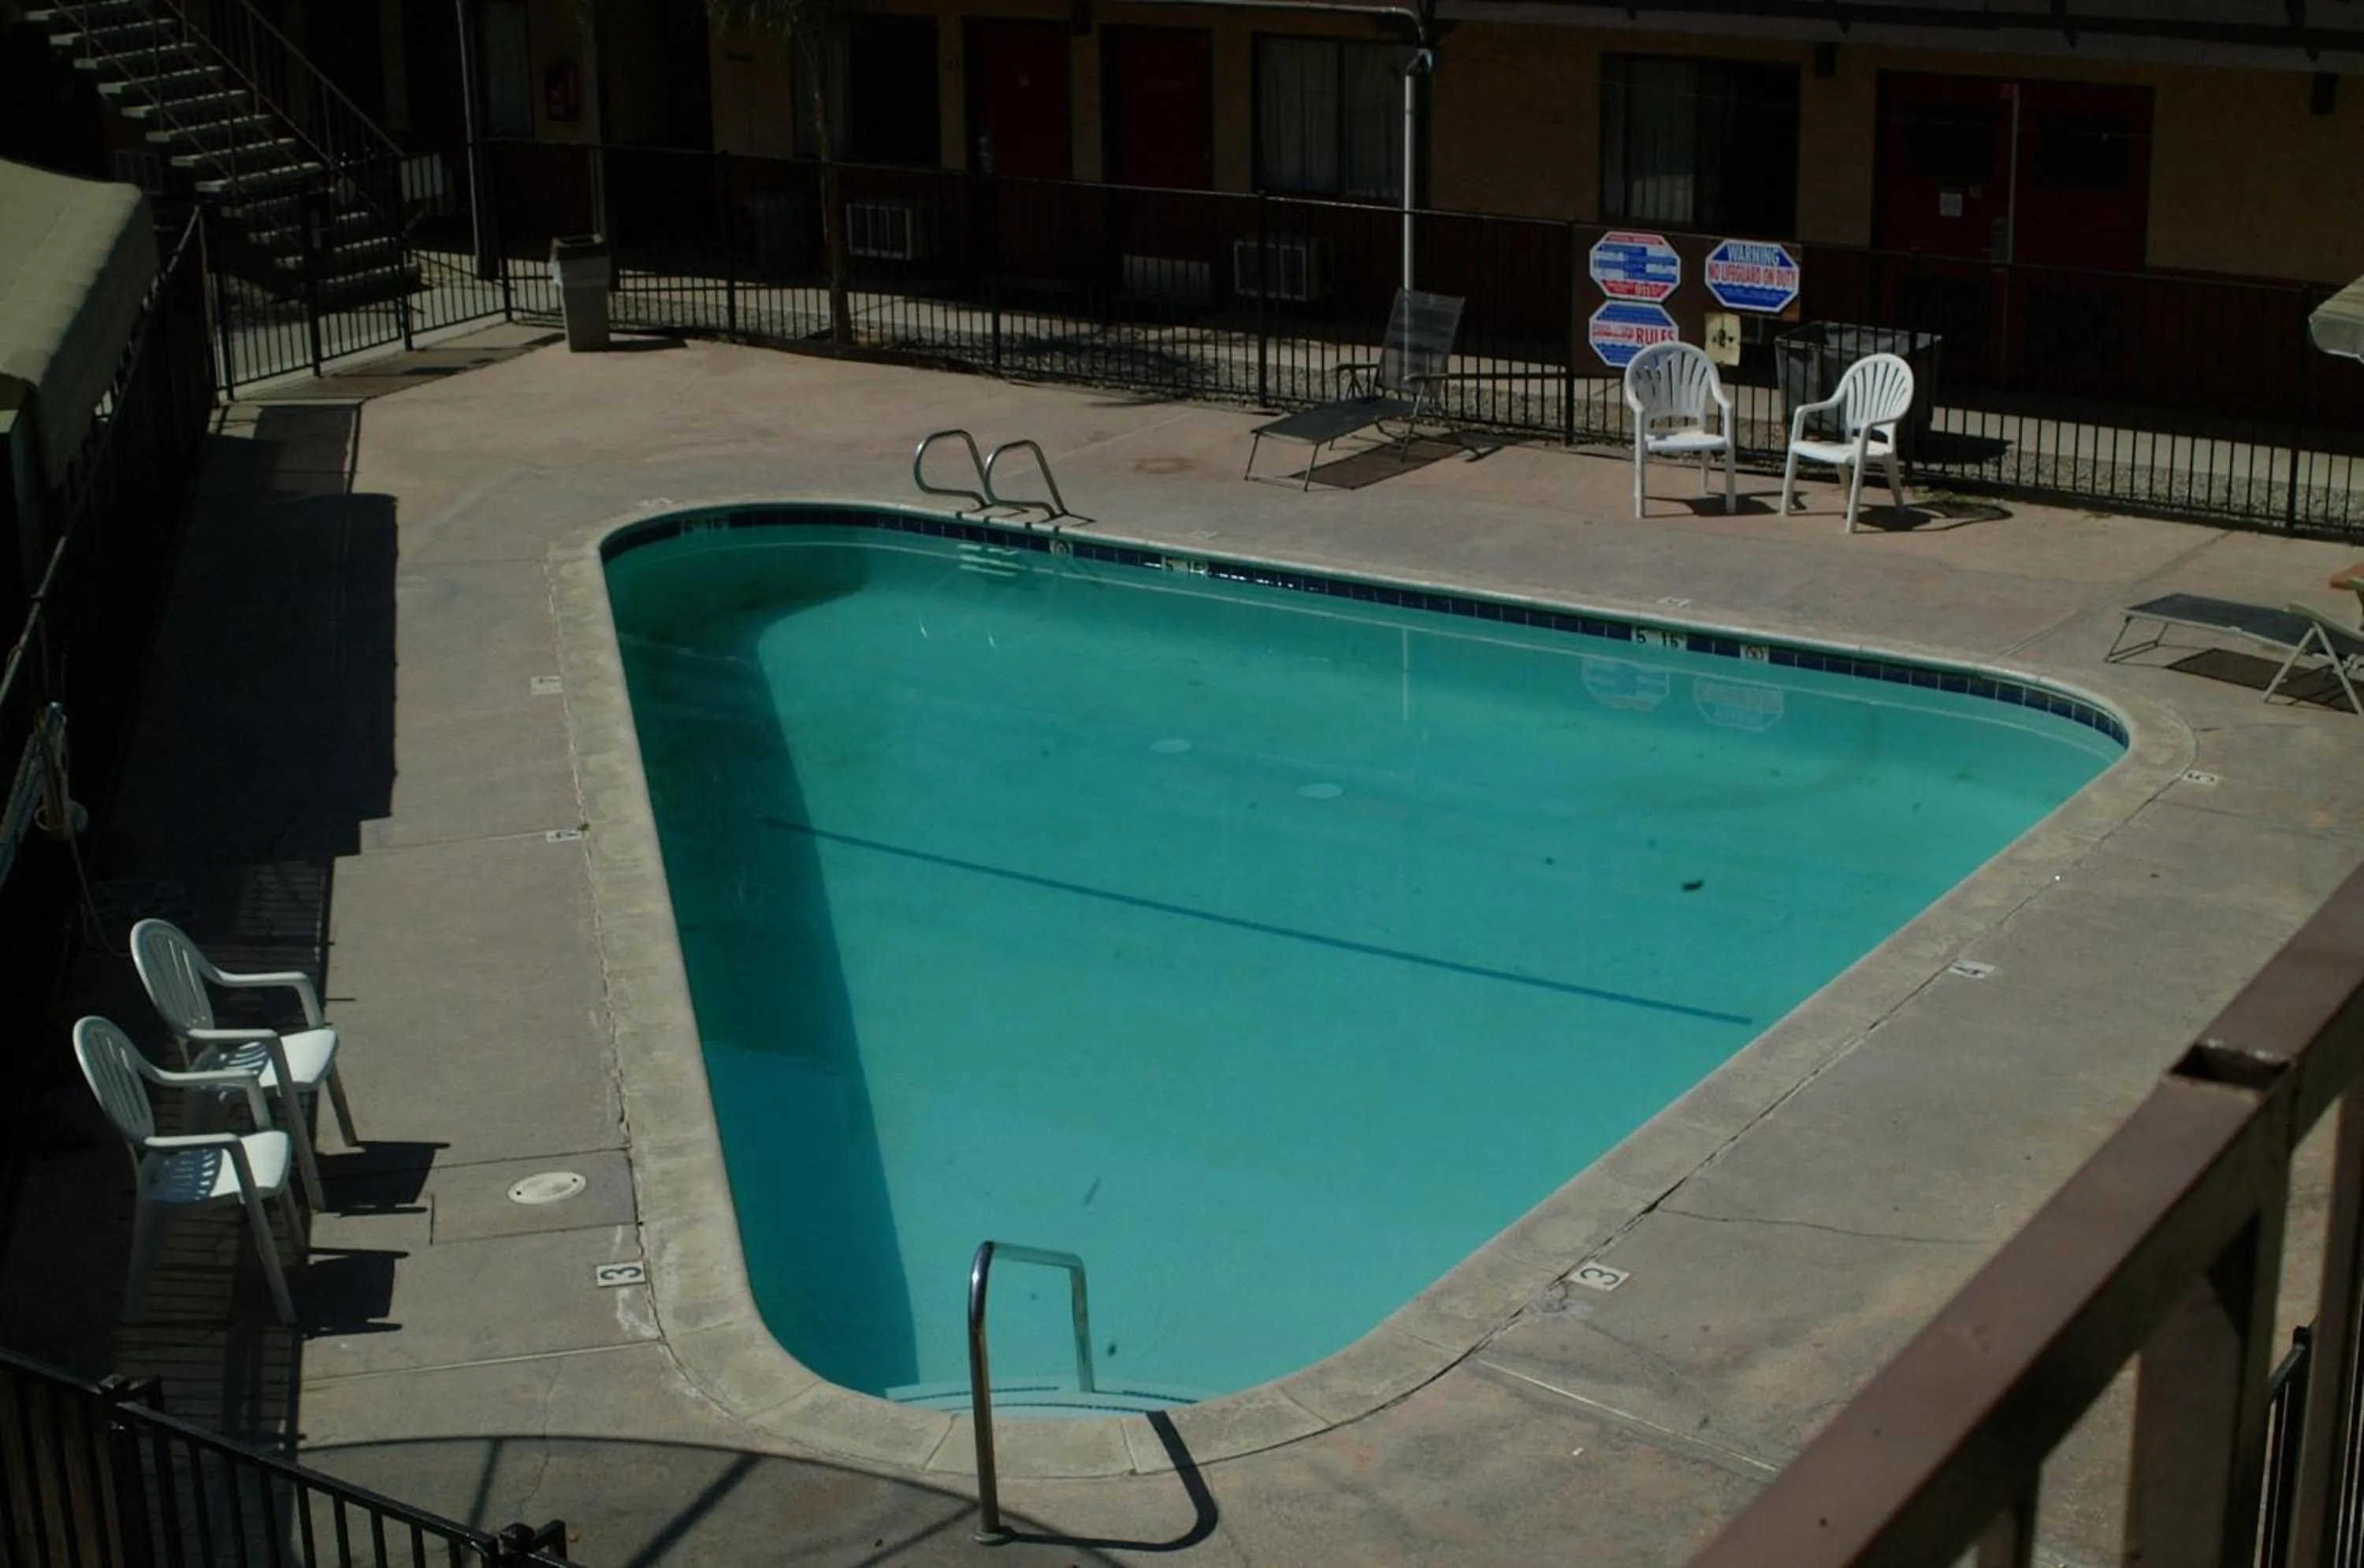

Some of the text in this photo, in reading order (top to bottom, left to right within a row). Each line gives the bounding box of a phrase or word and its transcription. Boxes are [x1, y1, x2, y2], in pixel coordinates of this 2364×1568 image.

[1727, 243, 1780, 266] WARNING
[1708, 262, 1796, 288] NO LIFEGUARD ON DUTY
[1635, 327, 1674, 344] RULES
[600, 1266, 642, 1280] 3
[1579, 1268, 1620, 1285] 3
